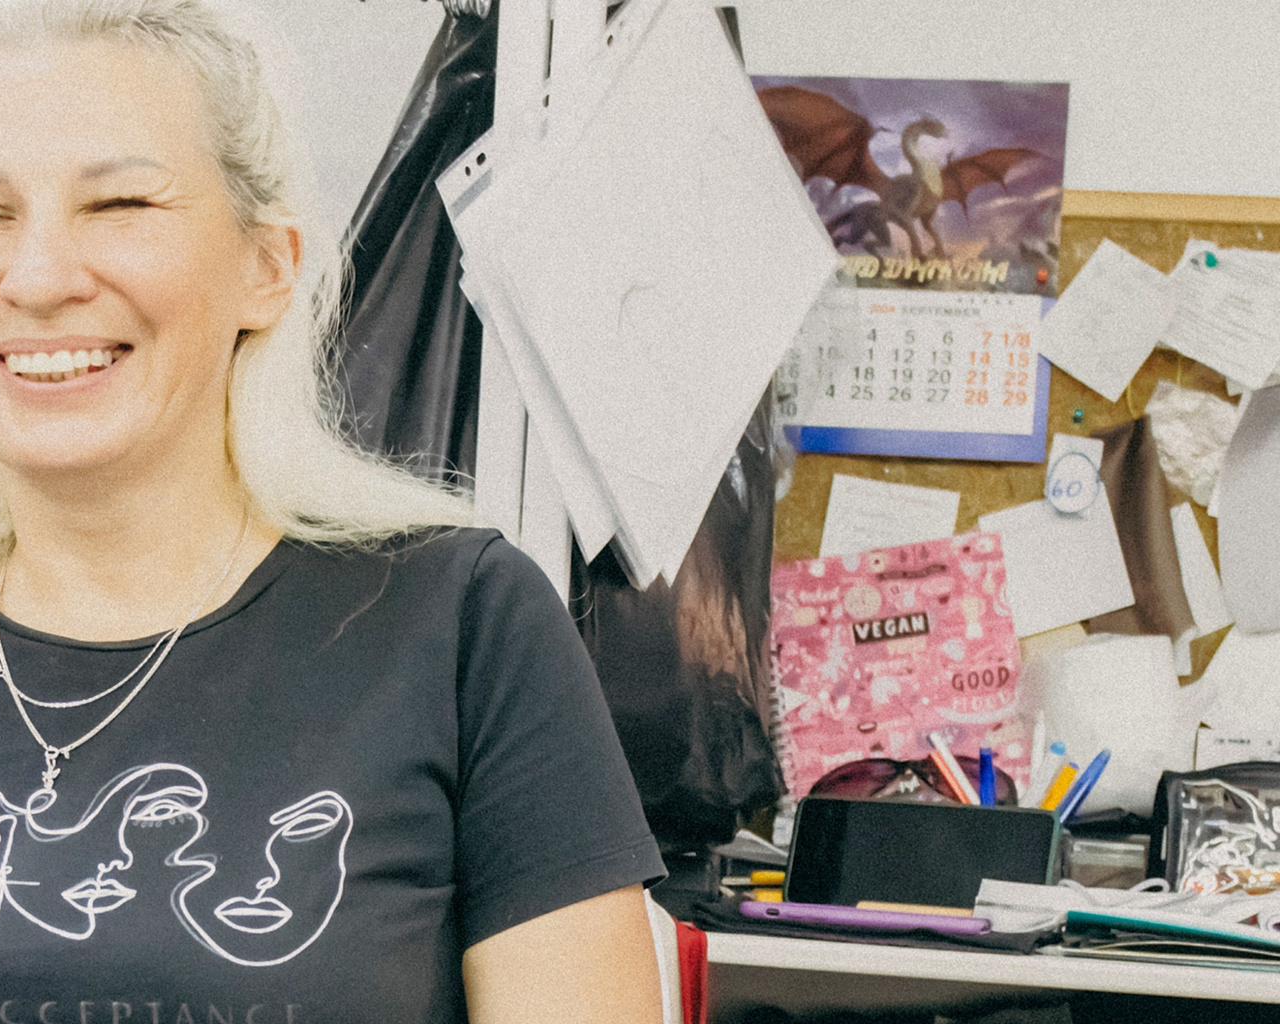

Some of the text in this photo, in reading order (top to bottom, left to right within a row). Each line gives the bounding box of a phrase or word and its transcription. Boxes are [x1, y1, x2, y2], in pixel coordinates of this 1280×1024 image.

[866, 328, 877, 342] 4
[904, 330, 916, 344] 5
[942, 331, 954, 346] 6
[982, 332, 994, 347] 7
[893, 350, 915, 364] 12
[931, 352, 952, 366] 13
[969, 351, 990, 366] 14
[853, 367, 875, 381] 18
[891, 368, 913, 382] 19
[928, 369, 952, 384] 20
[966, 370, 988, 385] 21
[1004, 371, 1028, 387] 22
[851, 385, 874, 400] 25
[888, 387, 912, 401] 26
[927, 388, 951, 402] 27
[965, 389, 989, 405] 28
[1003, 390, 1027, 406] 29
[1052, 480, 1083, 498] 60
[855, 613, 926, 640] VEGAN
[951, 666, 1011, 691] GOOD
